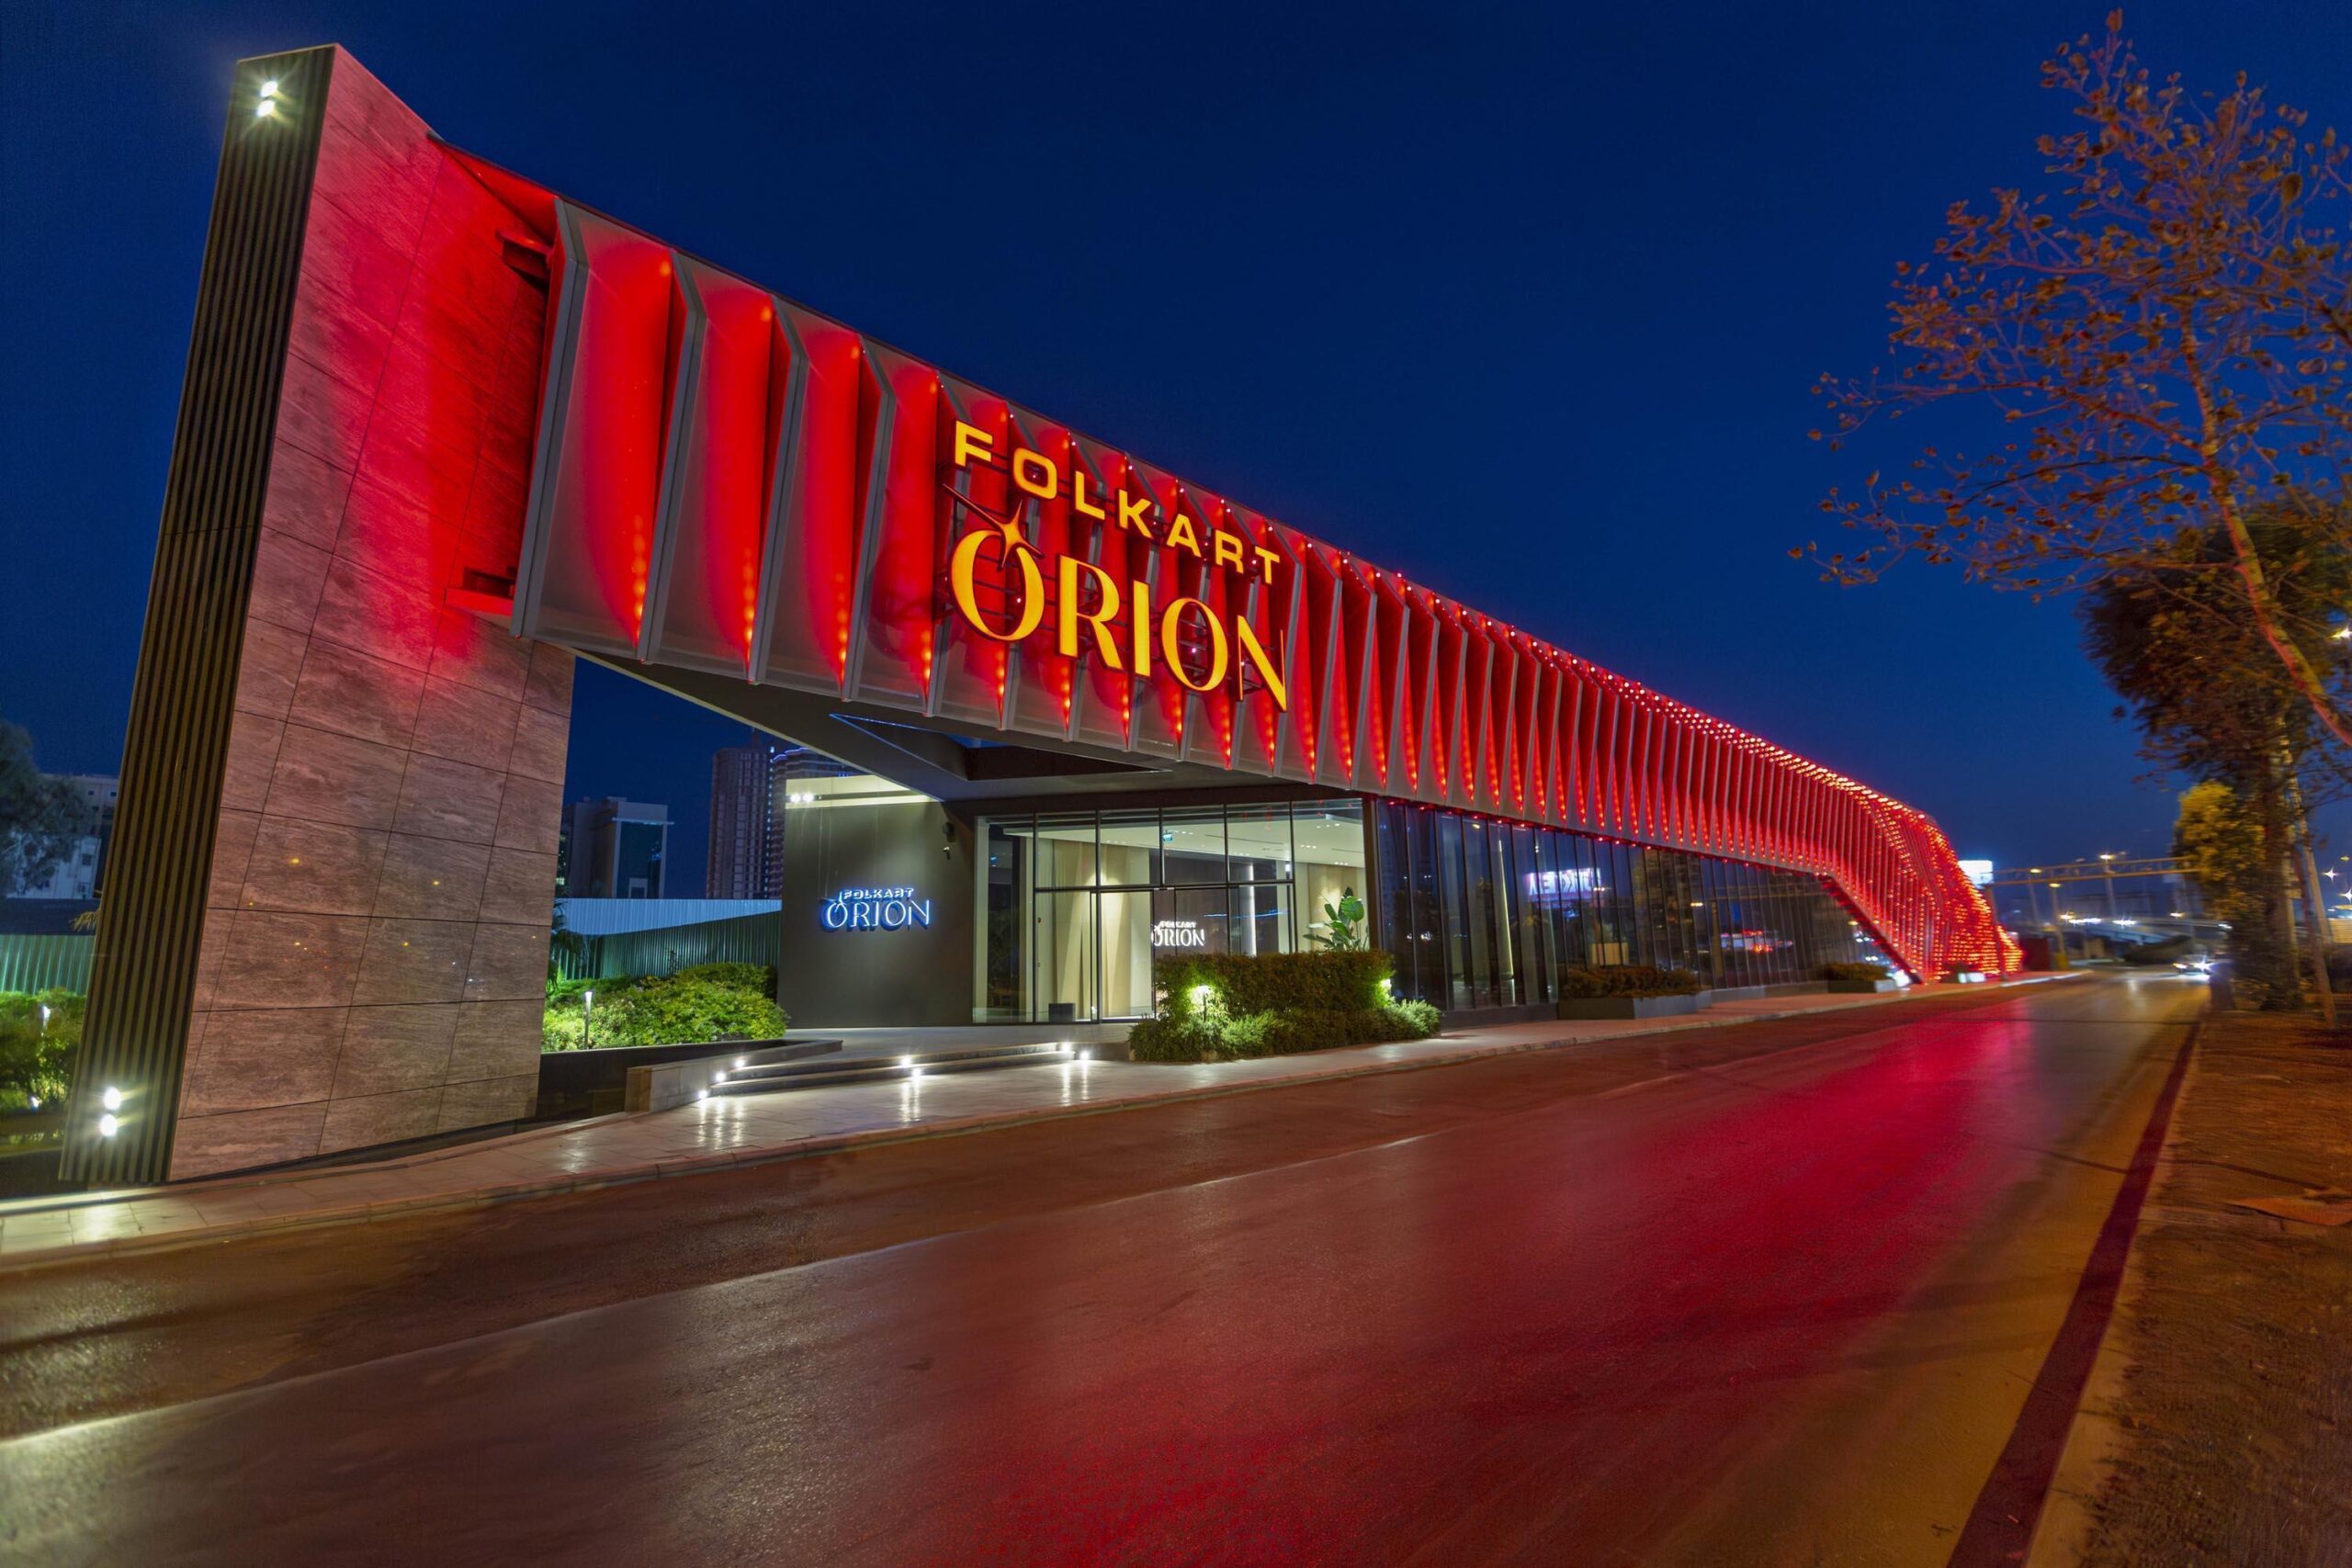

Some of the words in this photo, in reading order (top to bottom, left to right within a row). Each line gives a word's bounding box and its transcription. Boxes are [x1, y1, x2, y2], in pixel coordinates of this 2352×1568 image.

[954, 420, 1281, 585] FOLKART
[950, 529, 1287, 714] ORION
[843, 887, 914, 899] FOLKART
[827, 899, 930, 928] ORION
[1151, 928, 1205, 947] ORION
